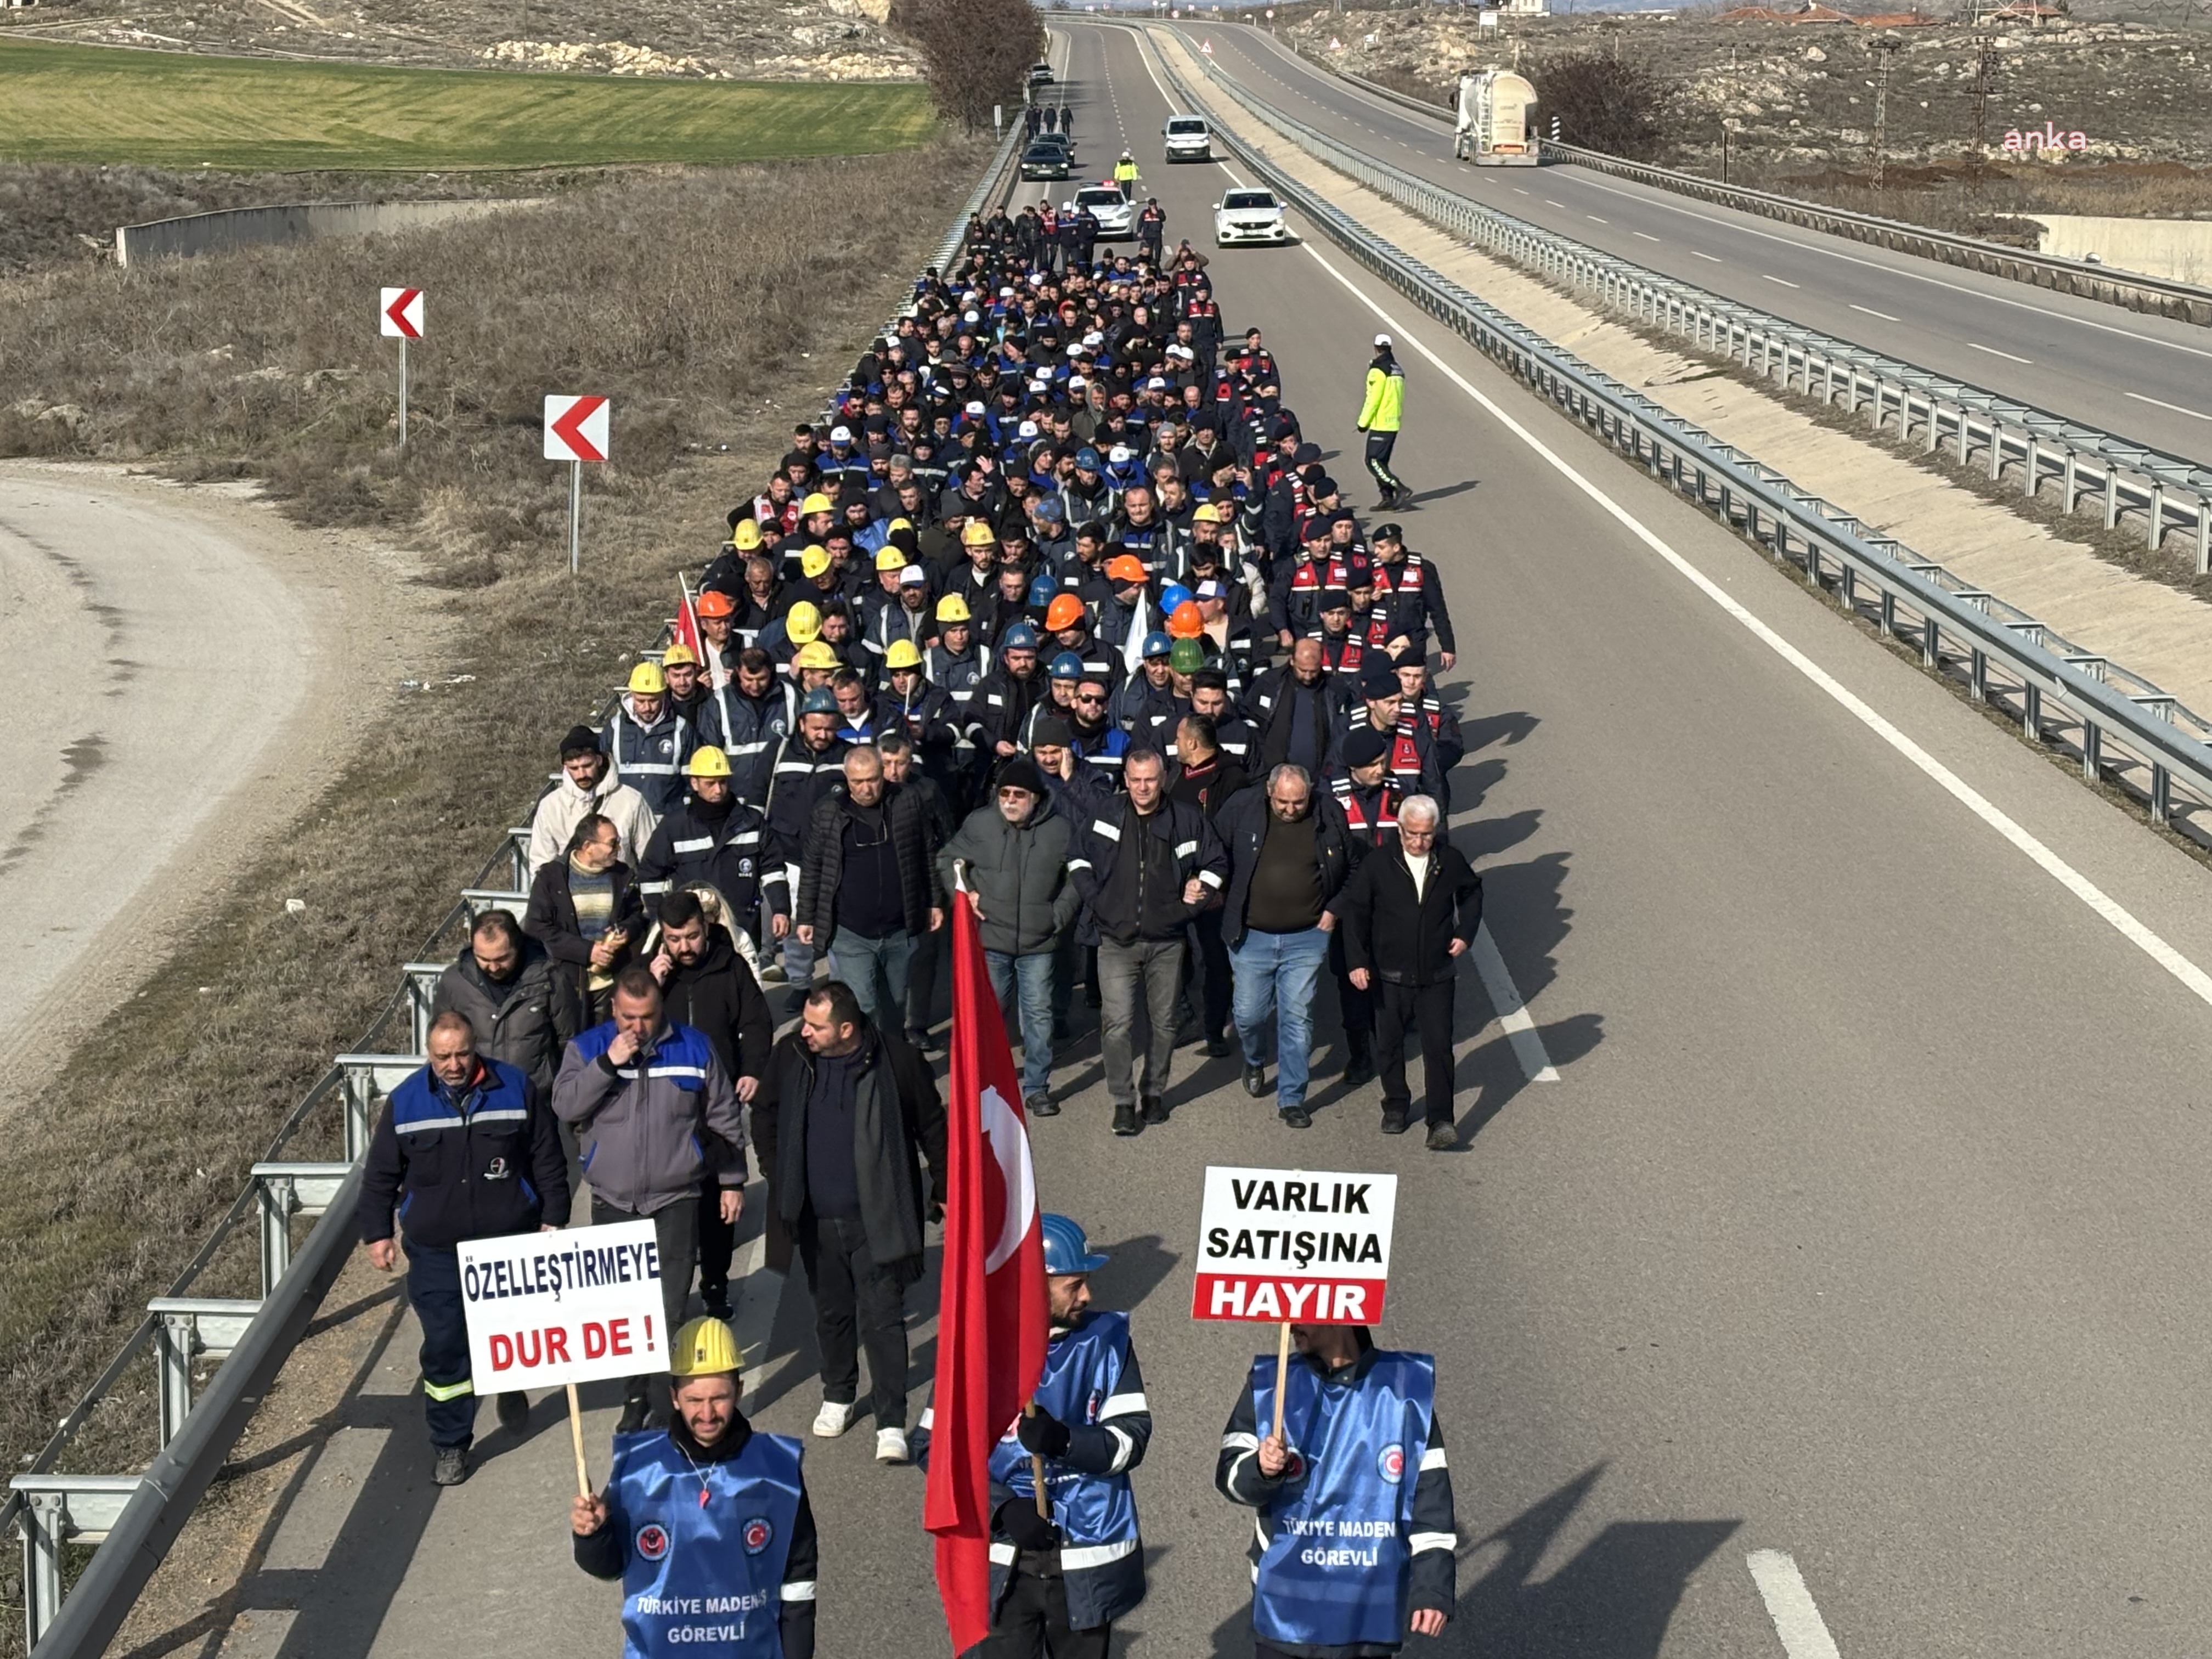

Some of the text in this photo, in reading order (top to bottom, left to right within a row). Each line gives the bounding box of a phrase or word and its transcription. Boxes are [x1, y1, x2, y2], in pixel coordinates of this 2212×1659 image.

[1231, 1178, 1372, 1214] VARLIK
[1206, 1228, 1383, 1269] SATIŞINA
[465, 1241, 661, 1302] ÖZELLEŞTİRMEYE
[1210, 1280, 1366, 1320] HAYIR
[489, 1314, 654, 1372] DUR DE !
[1301, 1547, 1378, 1566] GÖREVLİ
[637, 1594, 701, 1615] TÜRKİYE
[668, 1621, 745, 1644] GÖREVLİ
